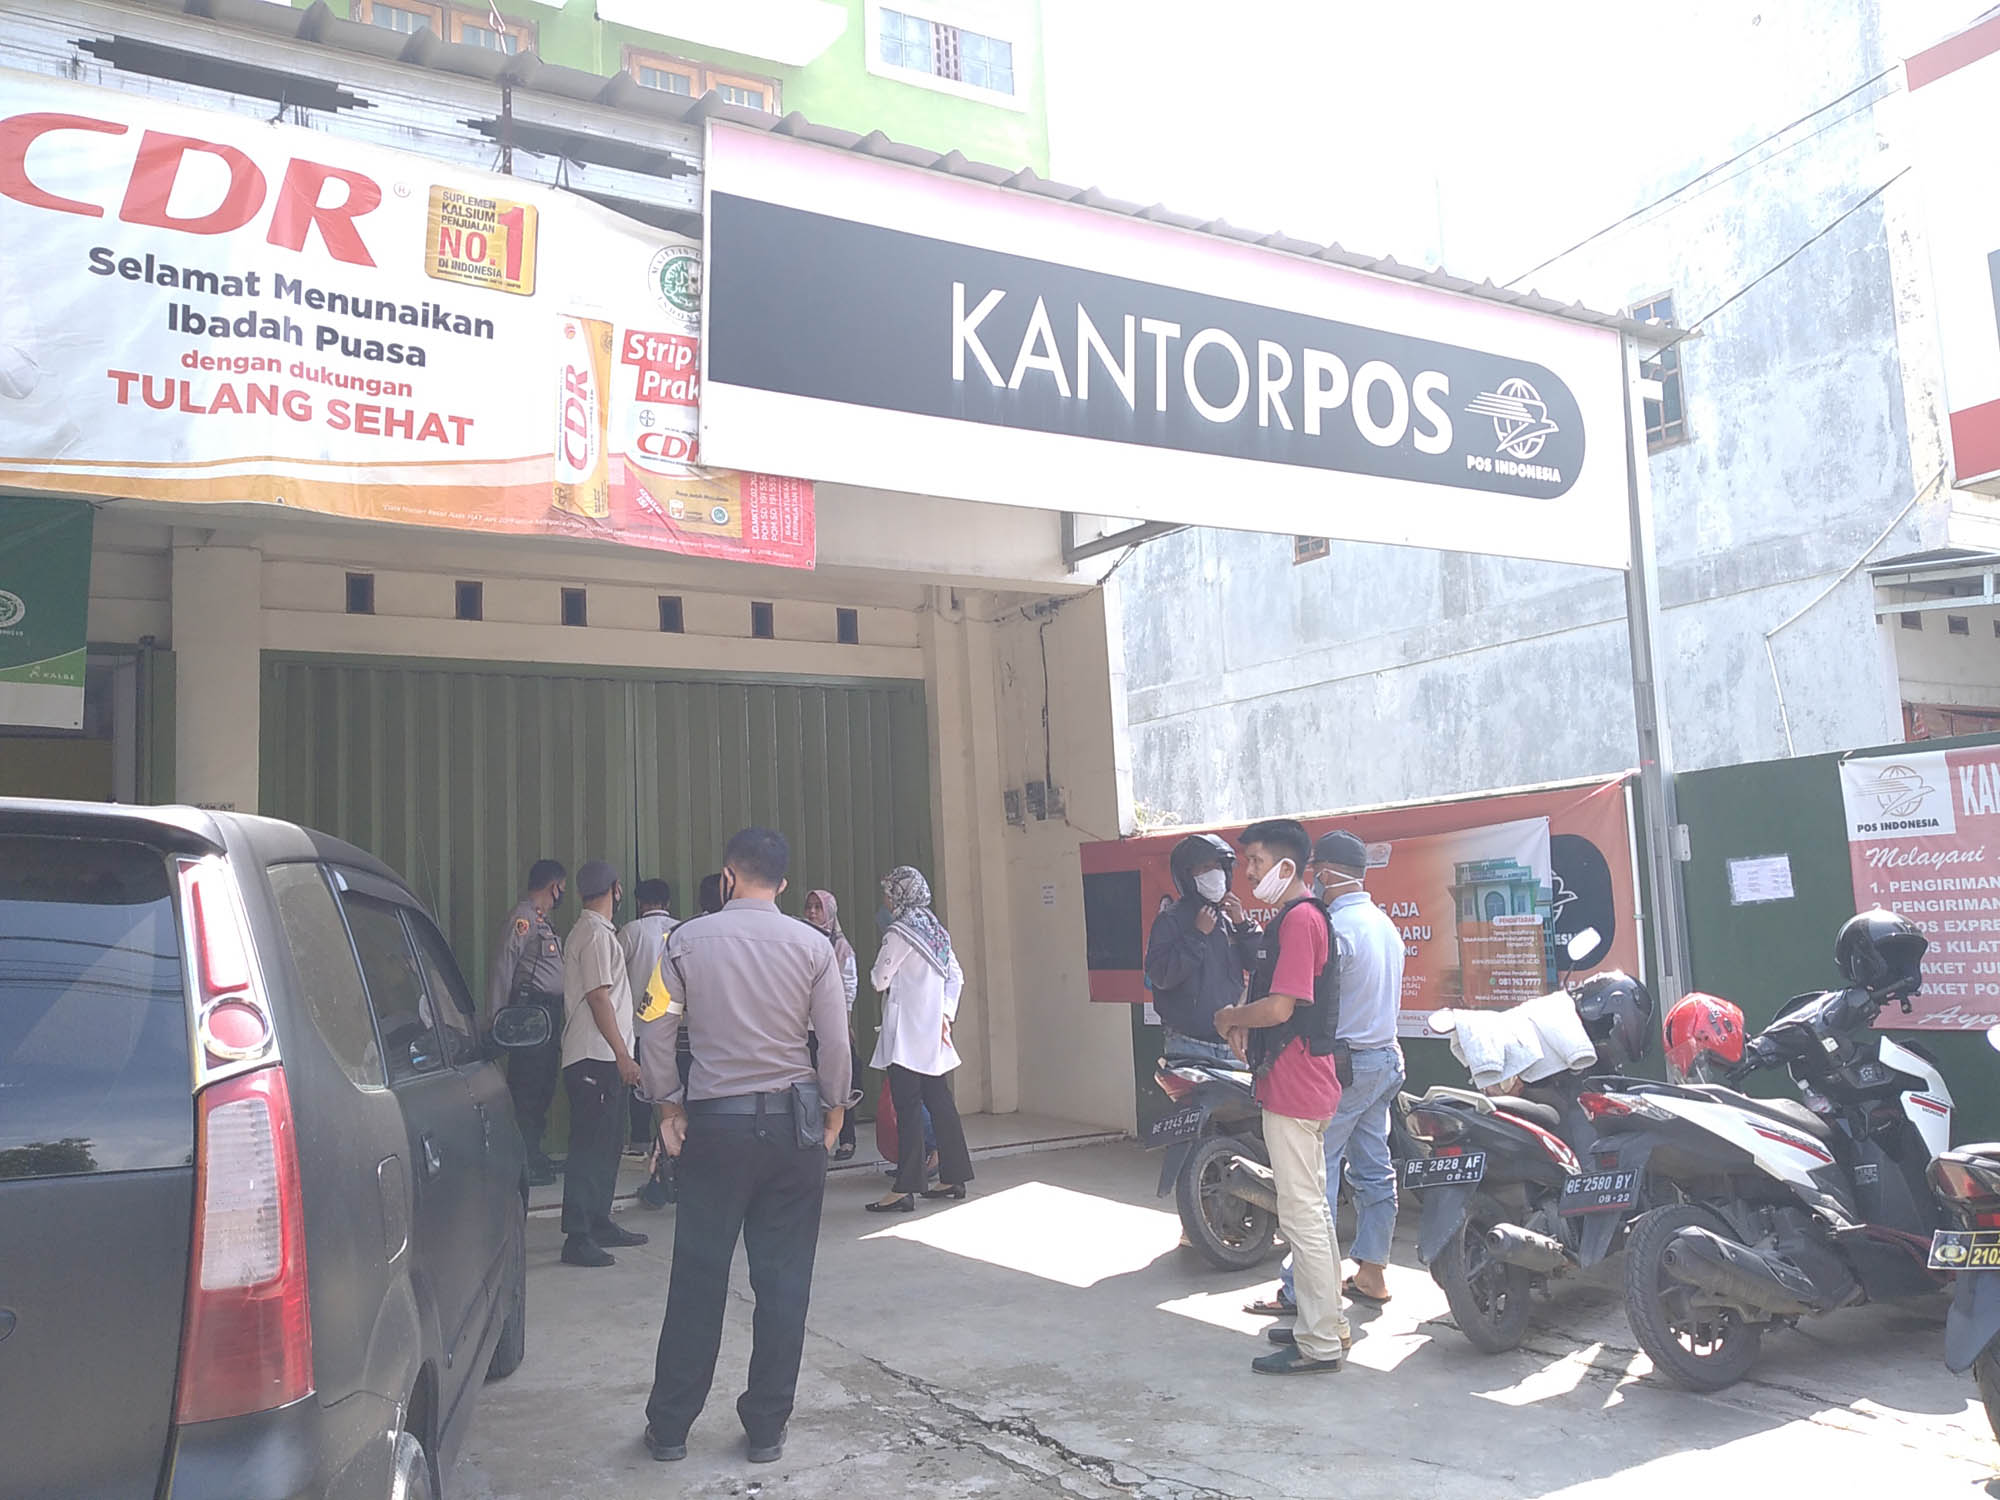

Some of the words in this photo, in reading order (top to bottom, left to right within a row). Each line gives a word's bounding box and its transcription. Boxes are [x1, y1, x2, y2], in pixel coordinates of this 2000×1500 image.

[0, 112, 382, 268] CDR
[442, 191, 496, 210] SUPLEMEN
[441, 202, 496, 223] KALSIUM
[441, 214, 495, 234] PENJUALAN
[498, 206, 524, 281] 1
[438, 258, 449, 269] DI
[451, 260, 503, 279] INDONESIA
[88, 247, 260, 297] Selamat
[274, 273, 495, 340] Menunaikan
[167, 303, 303, 347] Ibadah
[316, 325, 427, 368] Puasa
[627, 334, 693, 371] Strip
[181, 349, 282, 375] dengan
[289, 361, 413, 398] dukungan
[107, 369, 313, 422] TULANG
[326, 399, 475, 446] SEHAT
[564, 364, 588, 471] CDR
[1466, 455, 1492, 472] POS
[1495, 459, 1562, 483] INDONESIA
[1857, 823, 1878, 833] POS
[1880, 818, 1940, 831] INDONESIA
[1865, 845, 1985, 871] Melayani
[1869, 881, 1885, 894] 1.
[1889, 876, 2000, 893] PENGIRIMAN
[1391, 901, 1420, 917] AJA
[1917, 920, 1939, 933] OS
[1946, 940, 2000, 953] KILAT
[1920, 962, 1966, 975] AKET
[1972, 961, 2000, 974] JU
[1918, 983, 1969, 995] AKET
[1918, 1005, 1999, 1030] Ayo
[1407, 1162, 1423, 1174] BE
[1429, 1158, 1459, 1172] 2828
[1465, 1155, 1482, 1169] AF
[1566, 1179, 1582, 1194] BE
[1584, 1175, 1612, 1192] 2580
[1615, 1173, 1632, 1190] BY
